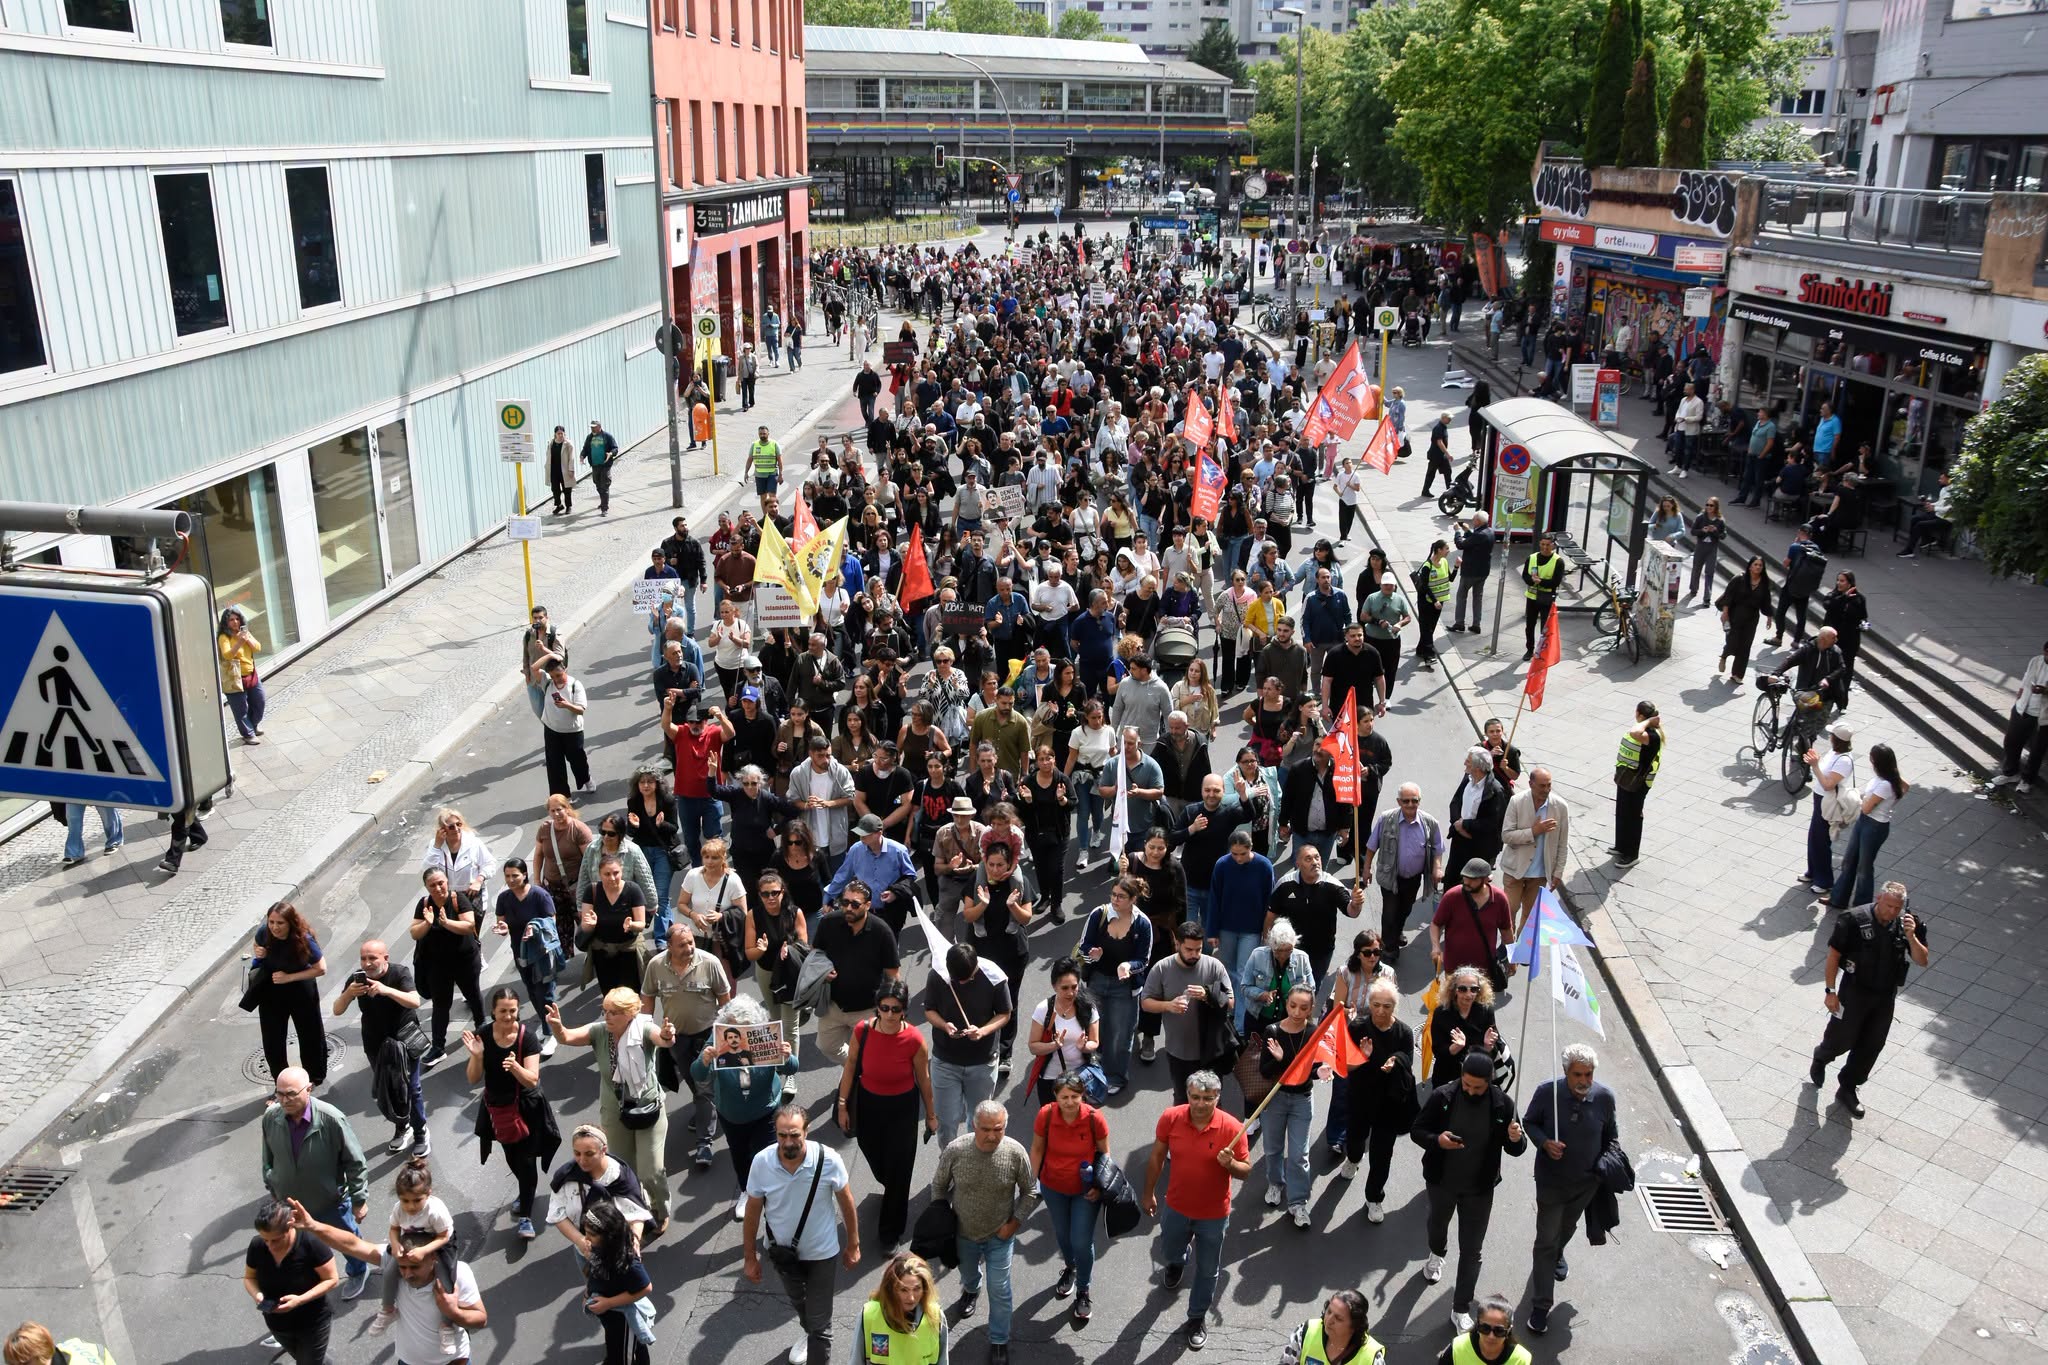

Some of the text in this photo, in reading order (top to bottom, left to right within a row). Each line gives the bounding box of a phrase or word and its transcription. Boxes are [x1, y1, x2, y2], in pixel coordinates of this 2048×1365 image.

[732, 195, 782, 225] ZAHNÄRZTE
[1604, 236, 1625, 246] ortel
[1920, 349, 1939, 360] Coffee
[1946, 354, 1963, 366] Cake
[507, 410, 518, 424] H
[750, 1043, 778, 1051] DERHAL
